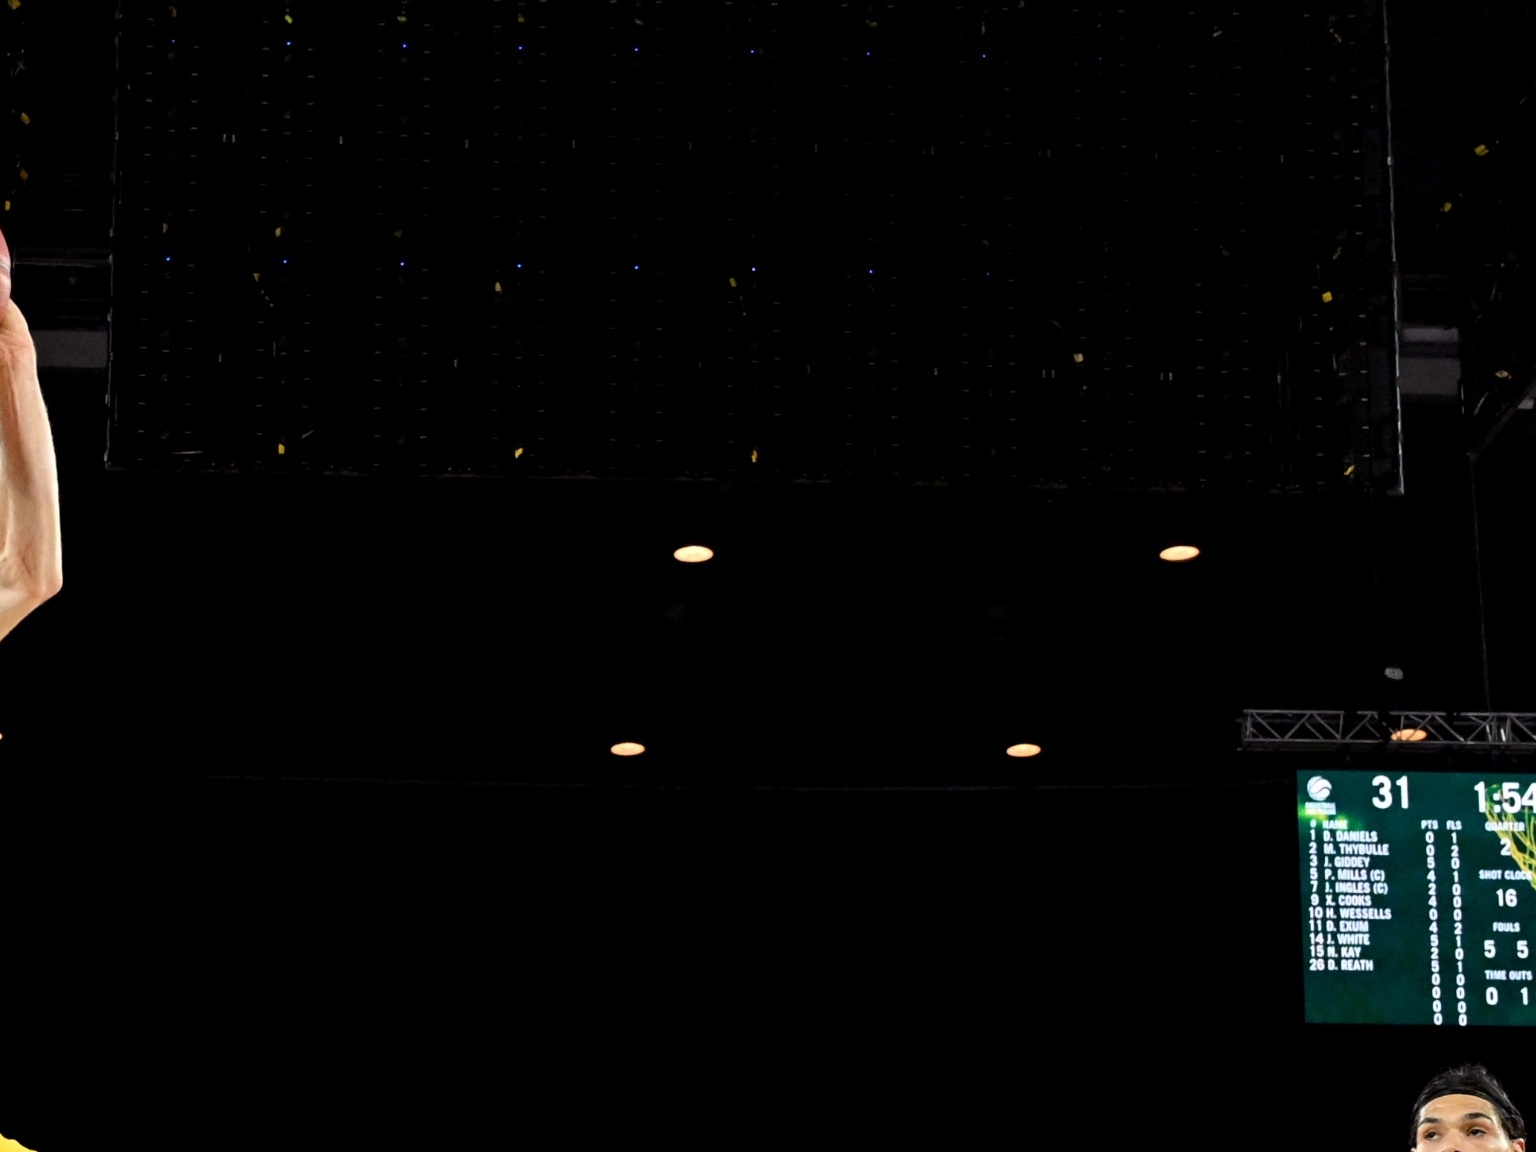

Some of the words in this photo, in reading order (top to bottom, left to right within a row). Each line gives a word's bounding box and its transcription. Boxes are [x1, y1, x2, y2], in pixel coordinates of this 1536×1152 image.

[1371, 775, 1410, 809] 31
[1421, 820, 1439, 830] PTS
[1310, 829, 1316, 841] 1
[1335, 830, 1378, 842] DANIELS
[1425, 831, 1434, 844] 0
[1451, 832, 1457, 844] 1
[1309, 842, 1317, 854] 2
[1338, 843, 1390, 856] THYBULLE
[1426, 844, 1435, 856] 0
[1451, 845, 1459, 857] 2
[1500, 838, 1512, 856] 2
[1309, 854, 1318, 867] 3
[1334, 856, 1370, 868] GIDDEY
[1427, 856, 1435, 869] 5
[1451, 857, 1460, 870] 0
[1309, 867, 1318, 880] 5
[1337, 868, 1368, 880] MILLS
[1370, 869, 1385, 882] (C)
[1427, 869, 1436, 882] 4
[1452, 870, 1459, 883] 1
[1478, 869, 1502, 880] SHOT
[1310, 880, 1318, 893] 7
[1335, 882, 1371, 893] INGLES
[1373, 882, 1389, 895] (C)
[1428, 883, 1436, 895] 2
[1452, 883, 1461, 896] 0
[1310, 893, 1319, 906] 9
[1338, 894, 1372, 906] COOKS
[1428, 895, 1437, 908] 4
[1453, 896, 1462, 908] 0
[1496, 888, 1518, 907] 16
[1309, 906, 1323, 919] 10
[1339, 907, 1392, 920] WESSELLS
[1429, 908, 1438, 921] 0
[1453, 909, 1462, 921] 0
[1309, 919, 1322, 932] 11
[1339, 920, 1369, 932] EXUM
[1429, 921, 1438, 934] 4
[1454, 922, 1462, 935] 2
[1492, 921, 1521, 933] FOULS
[1309, 932, 1324, 945] 14
[1337, 933, 1370, 945] WHITE
[1430, 934, 1439, 947] 5
[1455, 935, 1461, 947] 1
[1310, 945, 1324, 957] 15
[1341, 946, 1361, 958] KAY
[1430, 947, 1439, 960] 2
[1455, 948, 1464, 960] 0
[1484, 939, 1496, 959] 5
[1516, 940, 1529, 959] 5
[1309, 958, 1325, 971] 26
[1341, 959, 1374, 971] REATH
[1431, 960, 1440, 973] 5
[1457, 961, 1462, 973] 1
[1431, 973, 1441, 986] 0
[1456, 973, 1465, 986] 0
[1484, 969, 1507, 980] TIME
[1509, 970, 1533, 981] OUTS
[1432, 986, 1441, 999] 0
[1456, 986, 1465, 999] 0
[1485, 986, 1498, 1006] 0
[1520, 986, 1529, 1006] 1
[1432, 1000, 1442, 1013] 0
[1457, 1001, 1467, 1014] 0
[1433, 1013, 1443, 1026] 0
[1458, 1013, 1467, 1027] 0
